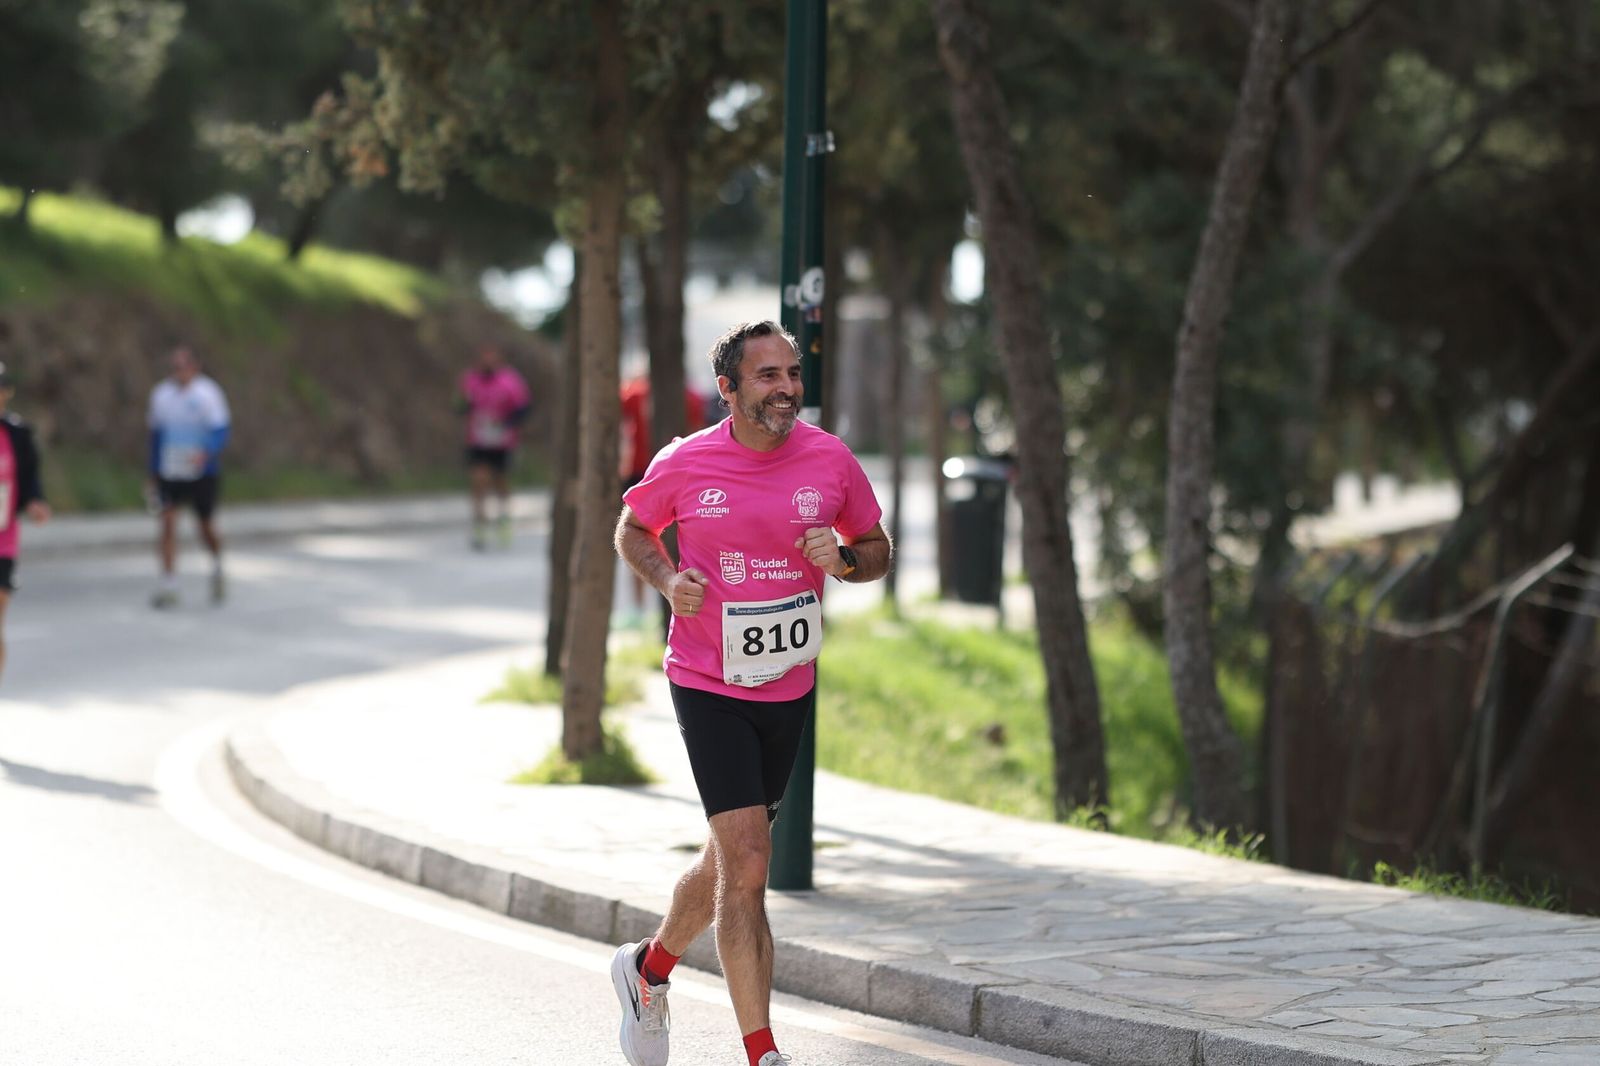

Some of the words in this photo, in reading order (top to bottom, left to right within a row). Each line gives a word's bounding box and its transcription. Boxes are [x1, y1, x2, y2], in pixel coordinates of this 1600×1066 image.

[695, 507, 730, 515] HYUNDAI
[750, 557, 788, 568] Ciudad
[752, 571, 766, 580] de
[768, 569, 803, 581] Málaga
[742, 618, 809, 656] 810
